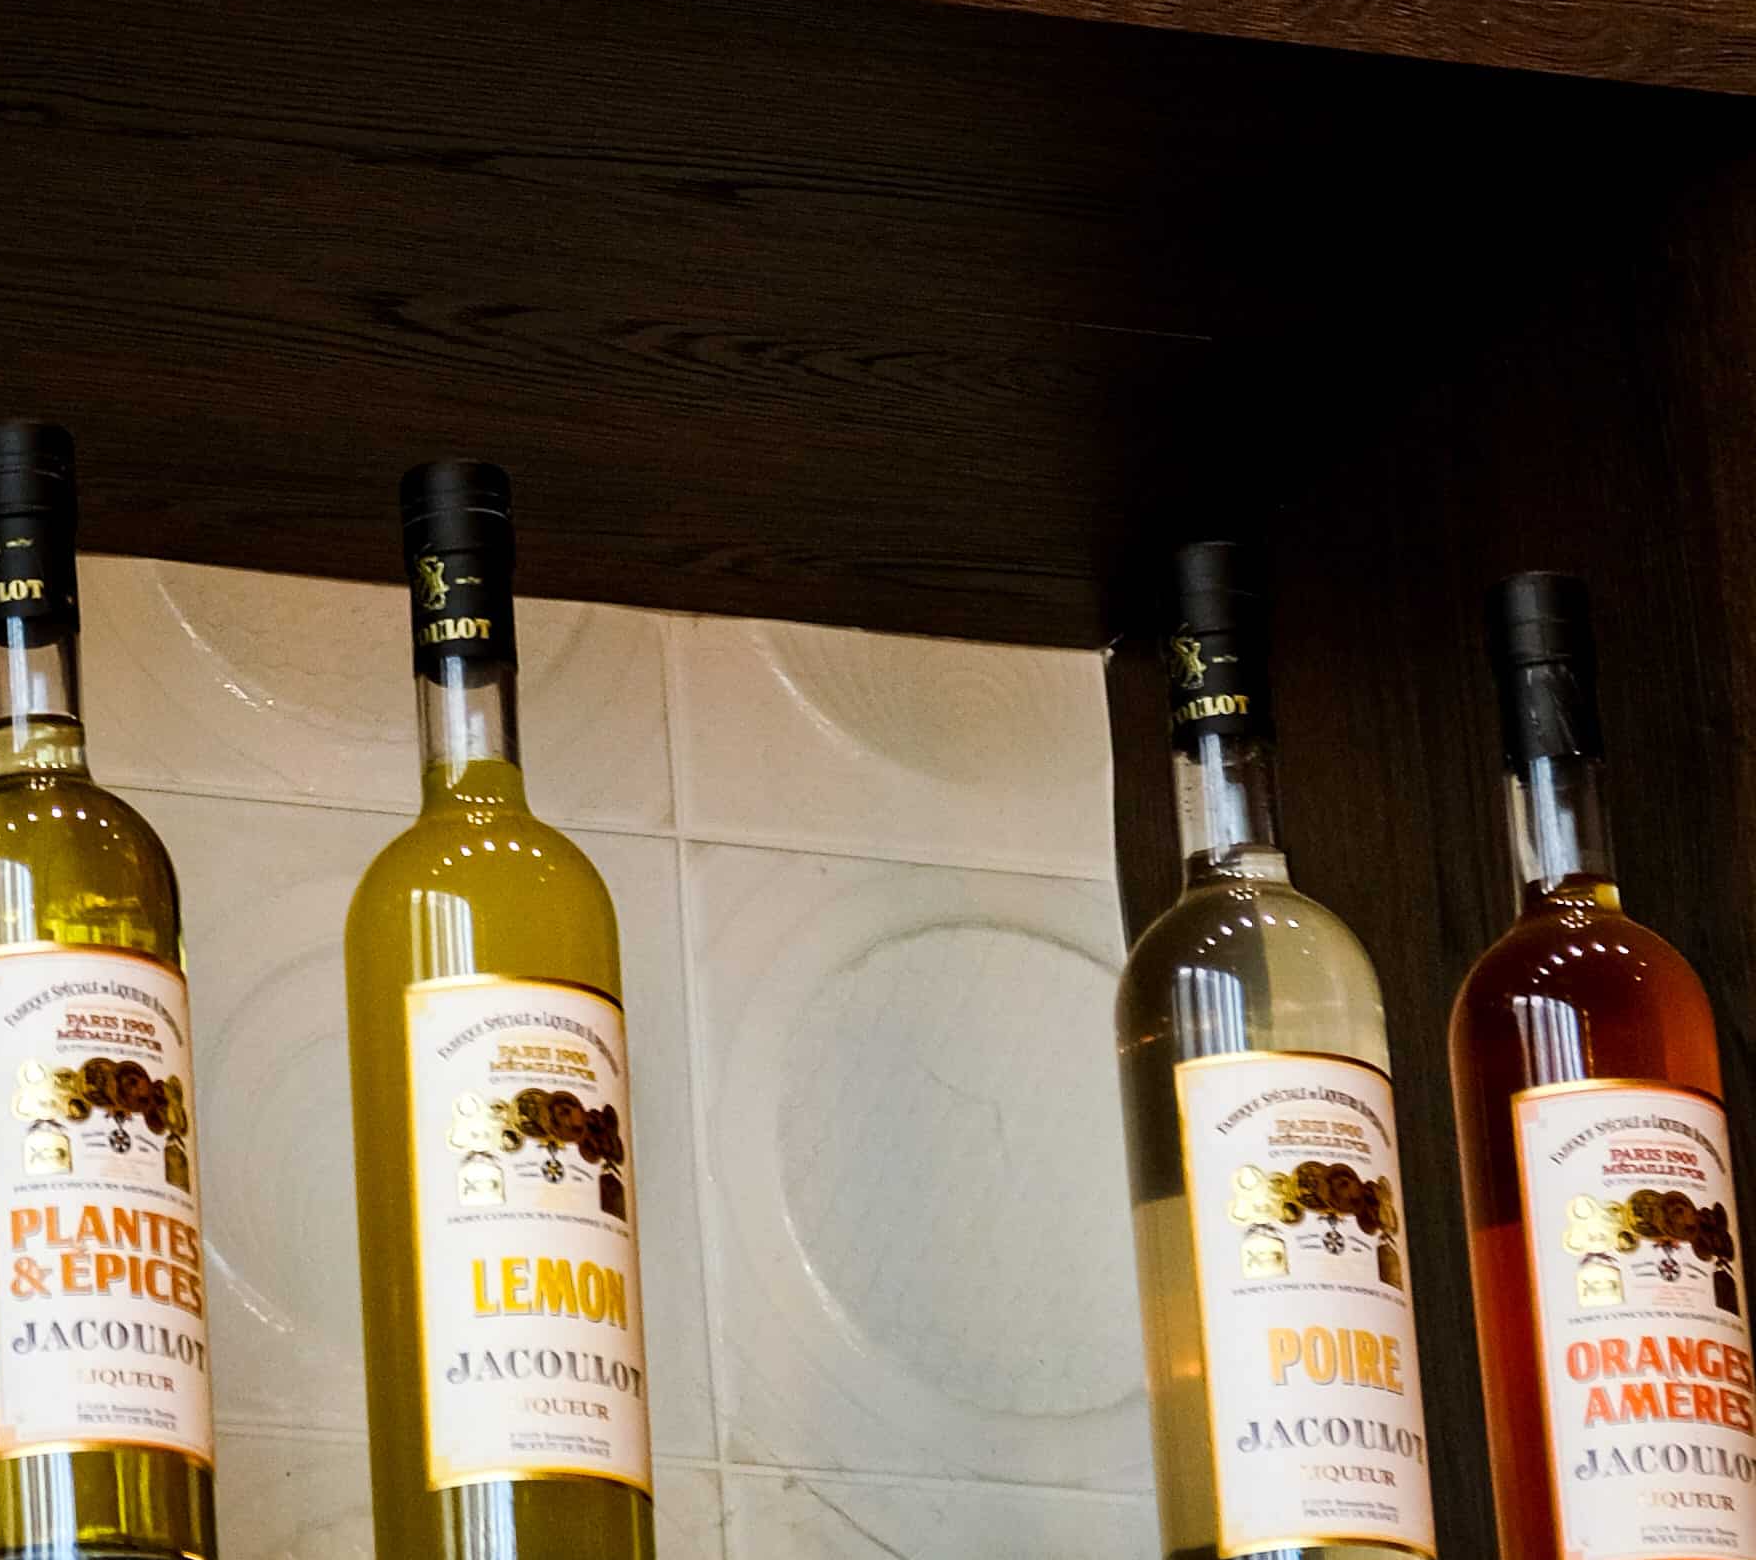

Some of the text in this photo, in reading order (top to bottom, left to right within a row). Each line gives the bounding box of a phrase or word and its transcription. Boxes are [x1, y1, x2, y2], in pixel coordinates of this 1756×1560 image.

[10, 1205, 198, 1273] PLANTES
[10, 1256, 52, 1298] &
[472, 1257, 628, 1330] LEMON
[12, 1320, 204, 1374] JACOULOT
[1268, 1327, 1404, 1396] POIRE
[1566, 1336, 1753, 1391] ORANGES
[447, 1350, 643, 1400] JACOULOT
[1236, 1417, 1424, 1465] JACOULOT
